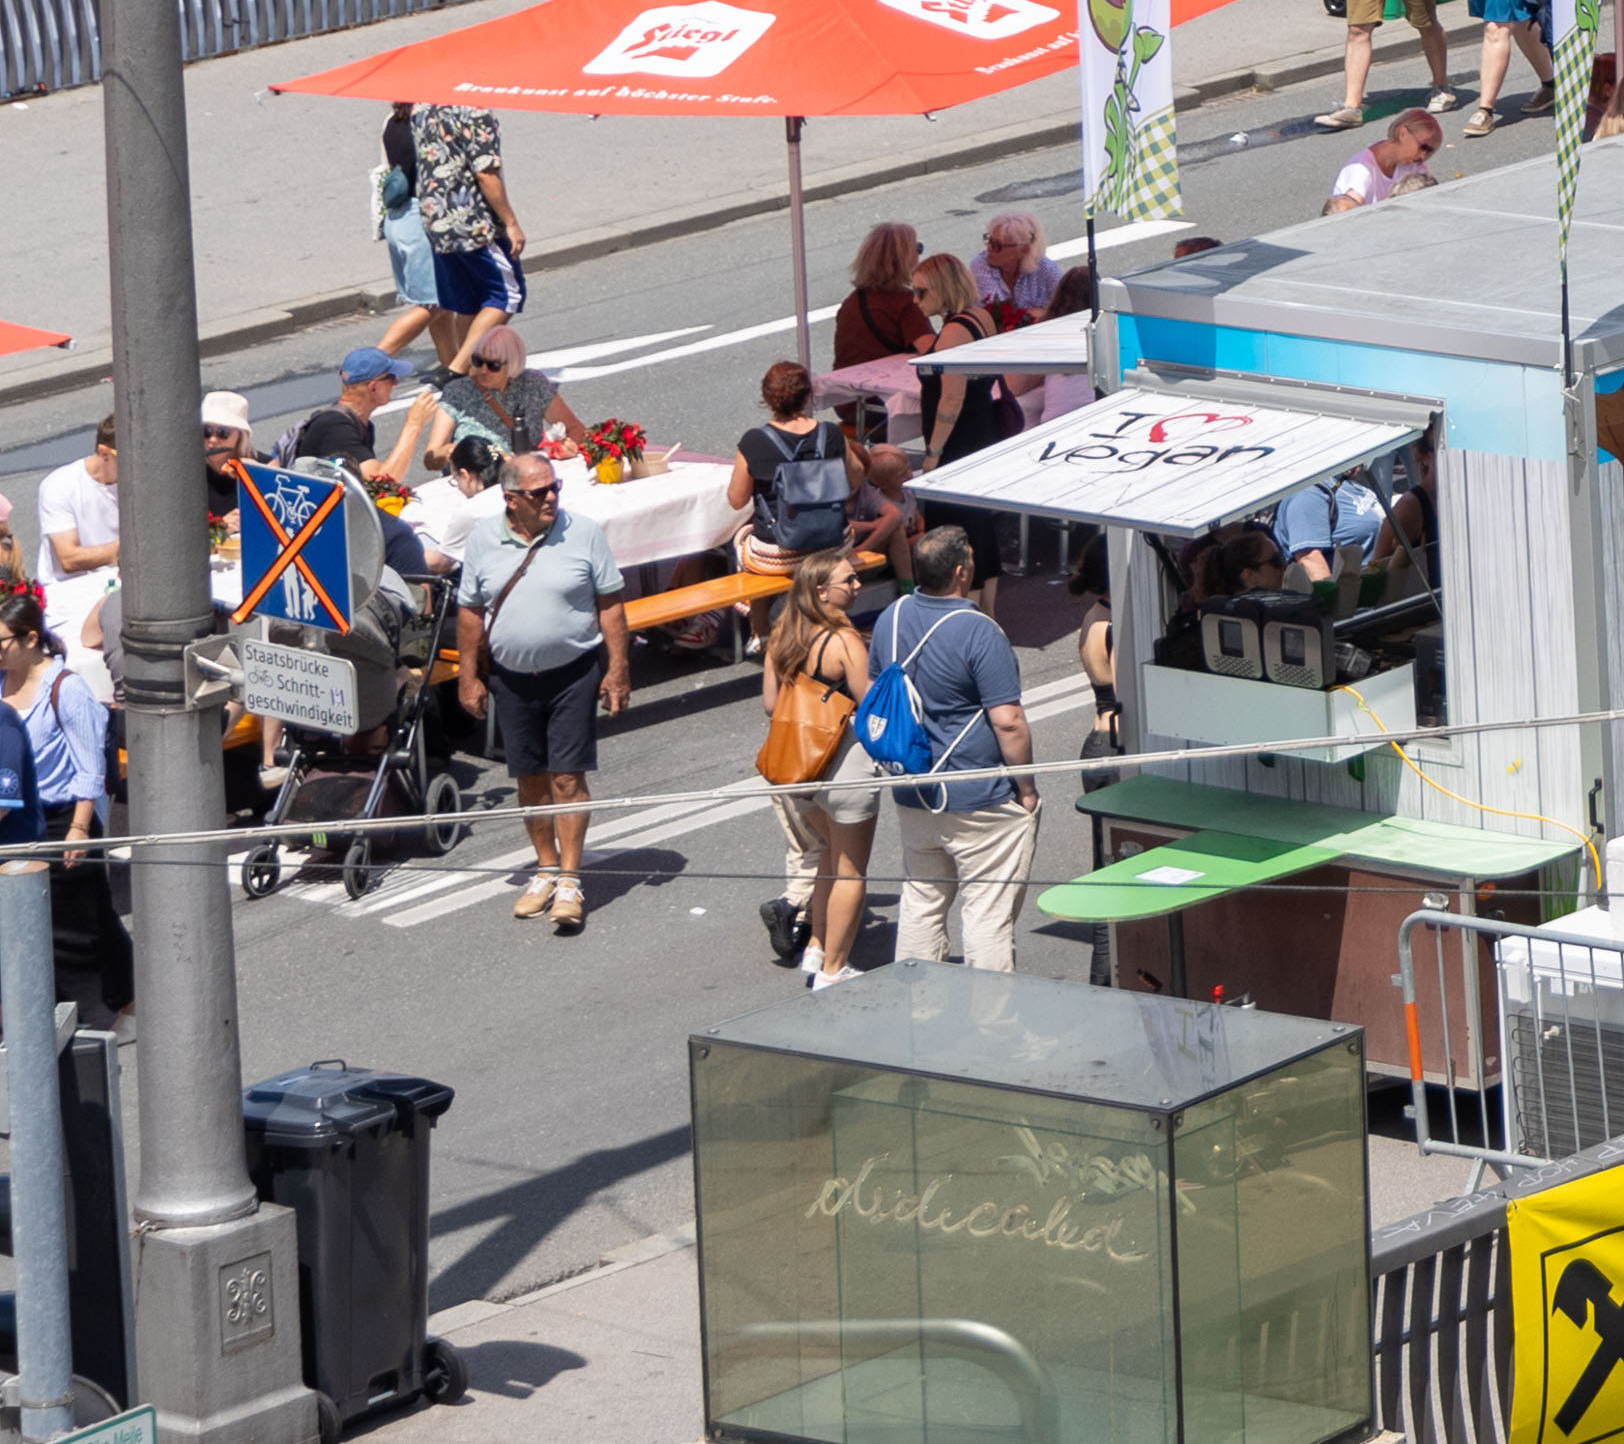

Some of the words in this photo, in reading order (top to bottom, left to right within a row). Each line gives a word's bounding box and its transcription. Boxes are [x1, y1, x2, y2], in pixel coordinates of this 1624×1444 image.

[623, 22, 739, 56] Stiegl
[245, 644, 329, 678] Staatsbrücke
[276, 674, 326, 699] Schritt-
[247, 693, 354, 729] geschwindigkeit
